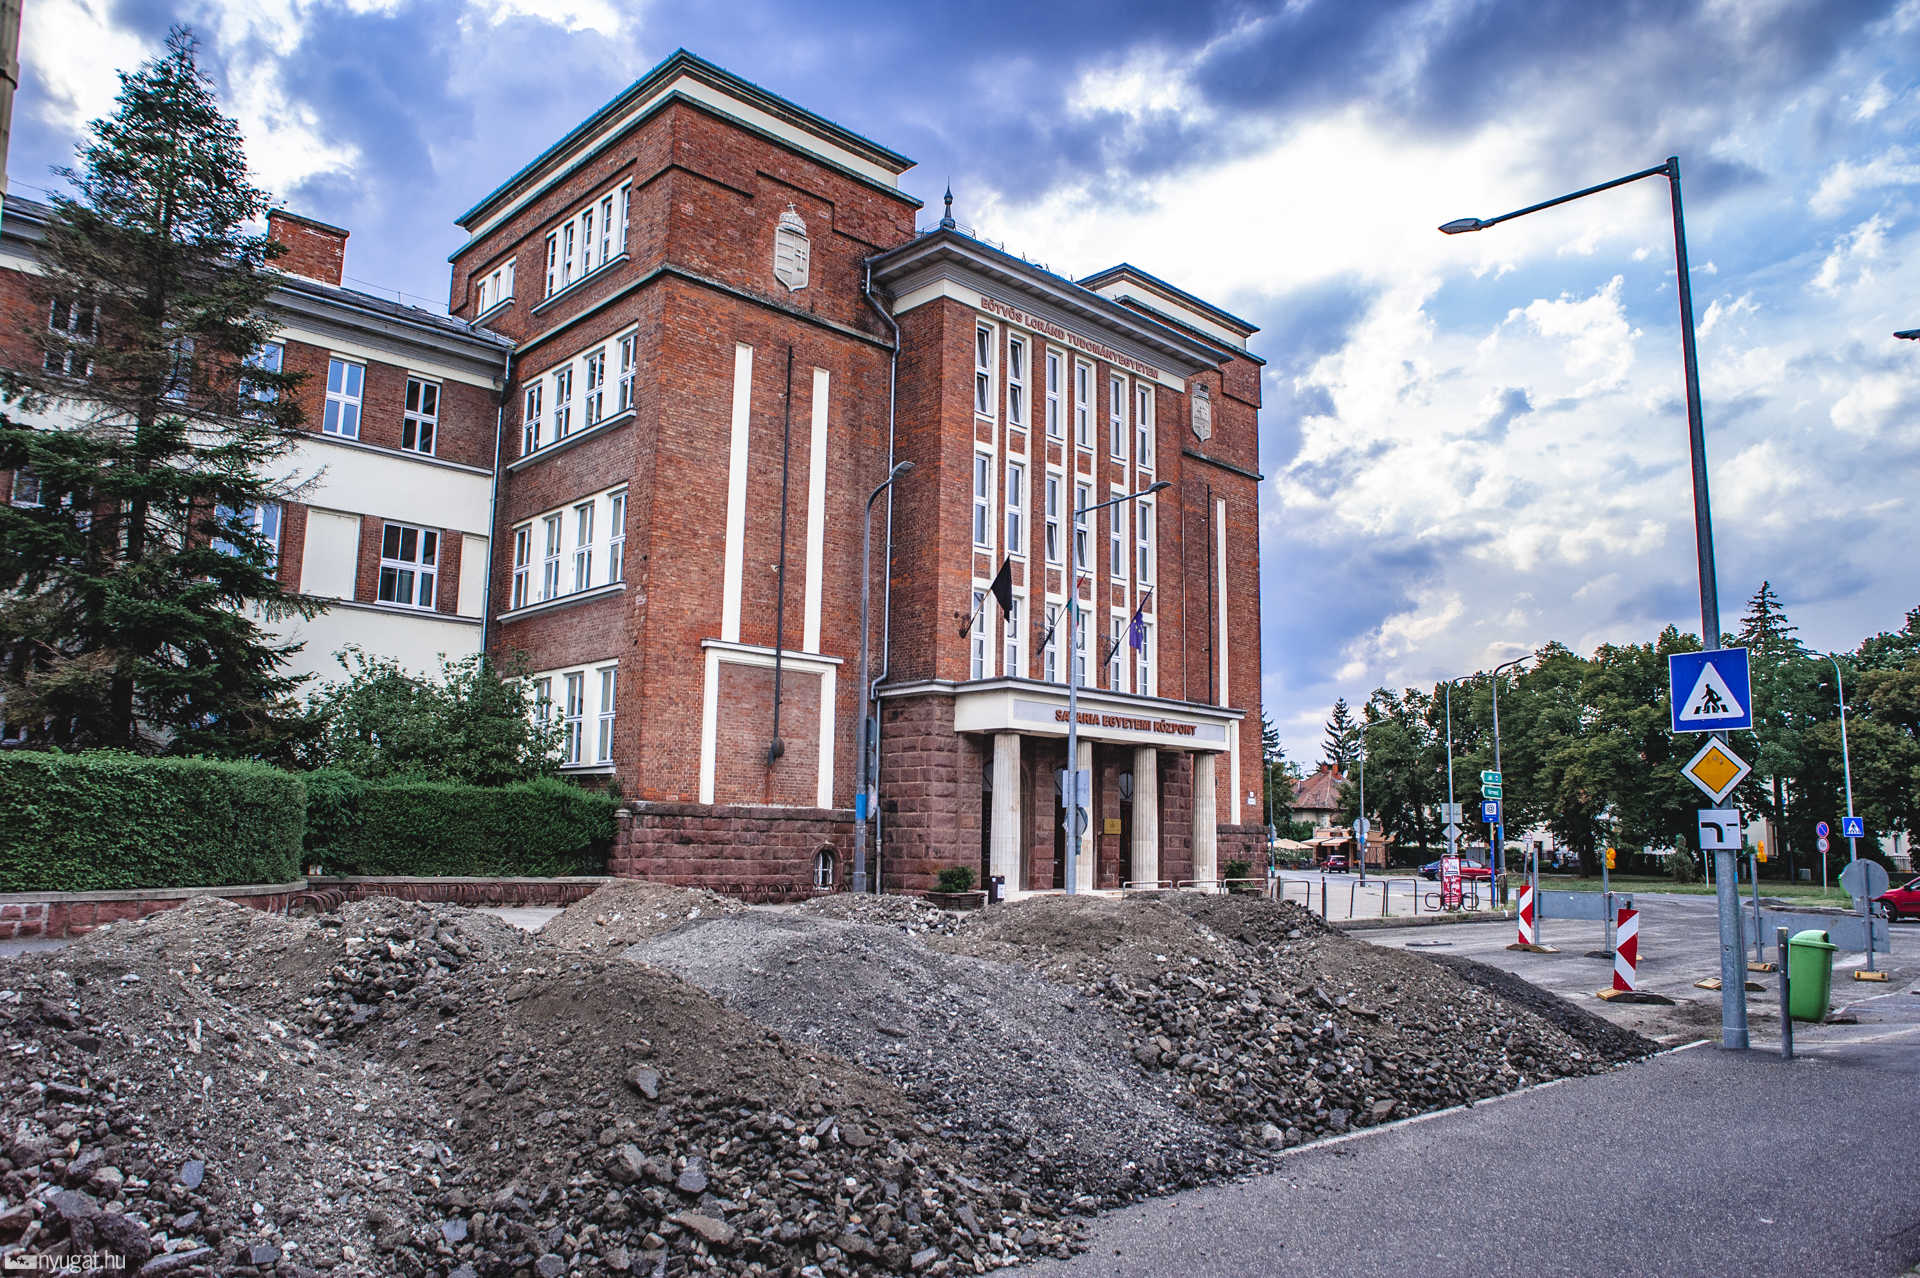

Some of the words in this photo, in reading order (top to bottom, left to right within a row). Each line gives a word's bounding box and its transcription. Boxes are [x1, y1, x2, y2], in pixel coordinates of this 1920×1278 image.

[981, 297, 1023, 322] EÖTVÖS
[1025, 315, 1065, 340] LORÁND
[1067, 333, 1159, 379] TUDOMÁNYEGYETEM
[1055, 709, 1100, 725] SAARIA
[1102, 715, 1152, 731] EGYETEMI
[1153, 719, 1198, 736] KÖZPONT
